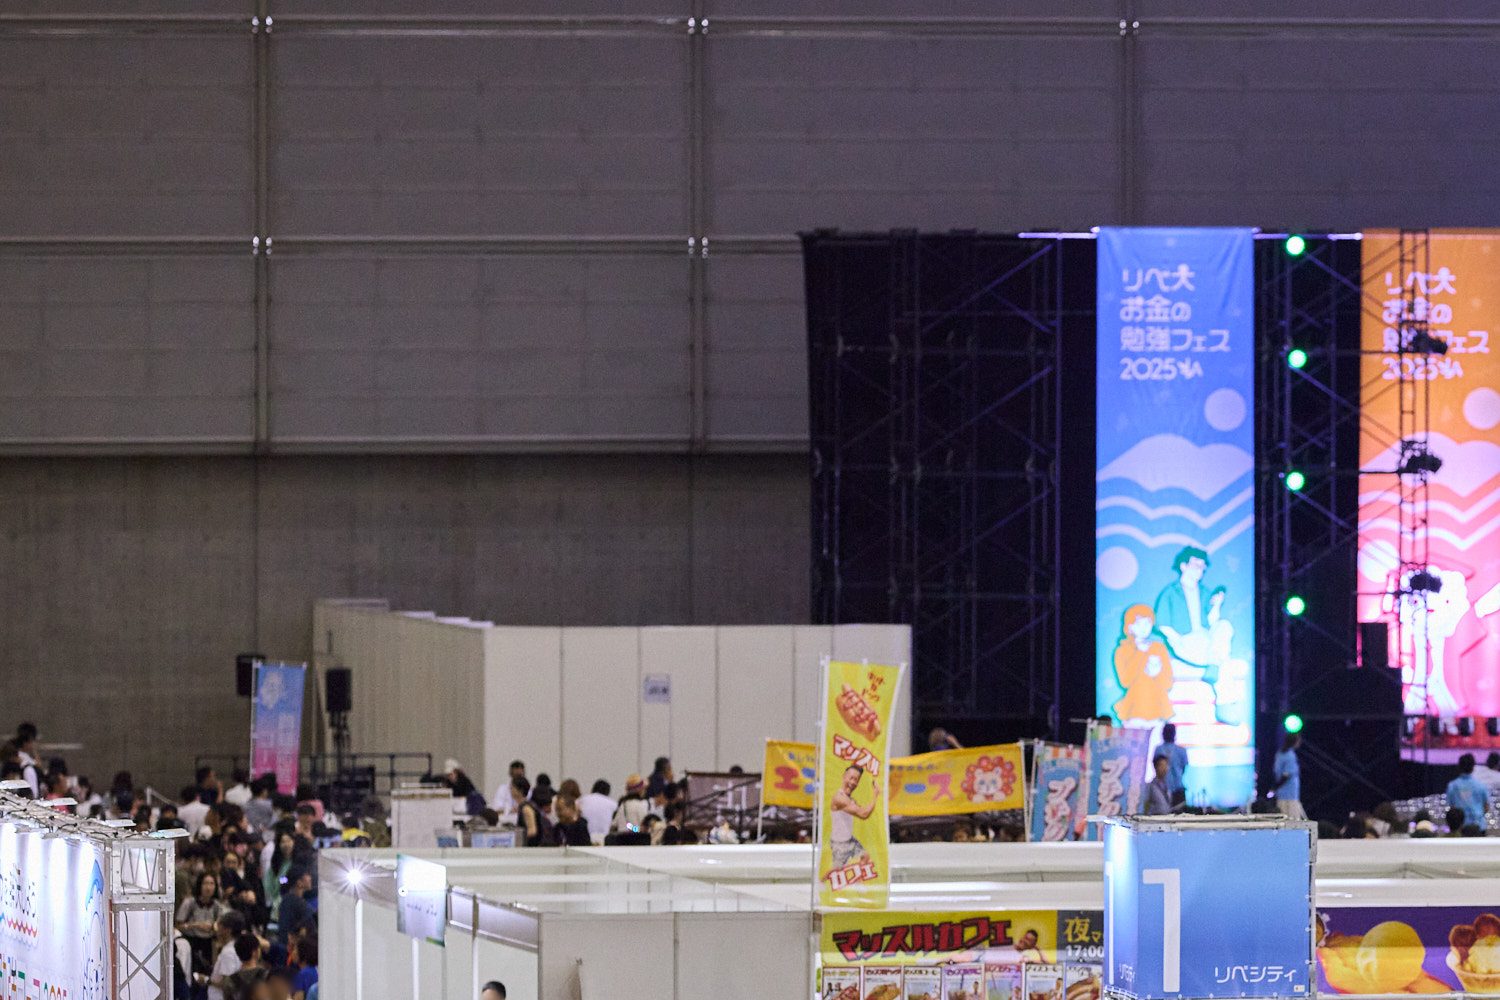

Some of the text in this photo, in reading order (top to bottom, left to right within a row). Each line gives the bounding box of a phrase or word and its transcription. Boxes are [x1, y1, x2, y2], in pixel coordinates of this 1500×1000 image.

[1122, 264, 1195, 292] リベ大
[1120, 294, 1191, 322] お金の
[1120, 326, 1231, 352] 勉強フェス
[1120, 357, 1178, 380] 2025
[833, 733, 880, 777] マッスル
[826, 861, 879, 892] カフェ
[833, 917, 1014, 962] マッスルカフェ
[1142, 868, 1181, 993] 1
[1214, 964, 1297, 984] リベシティ
